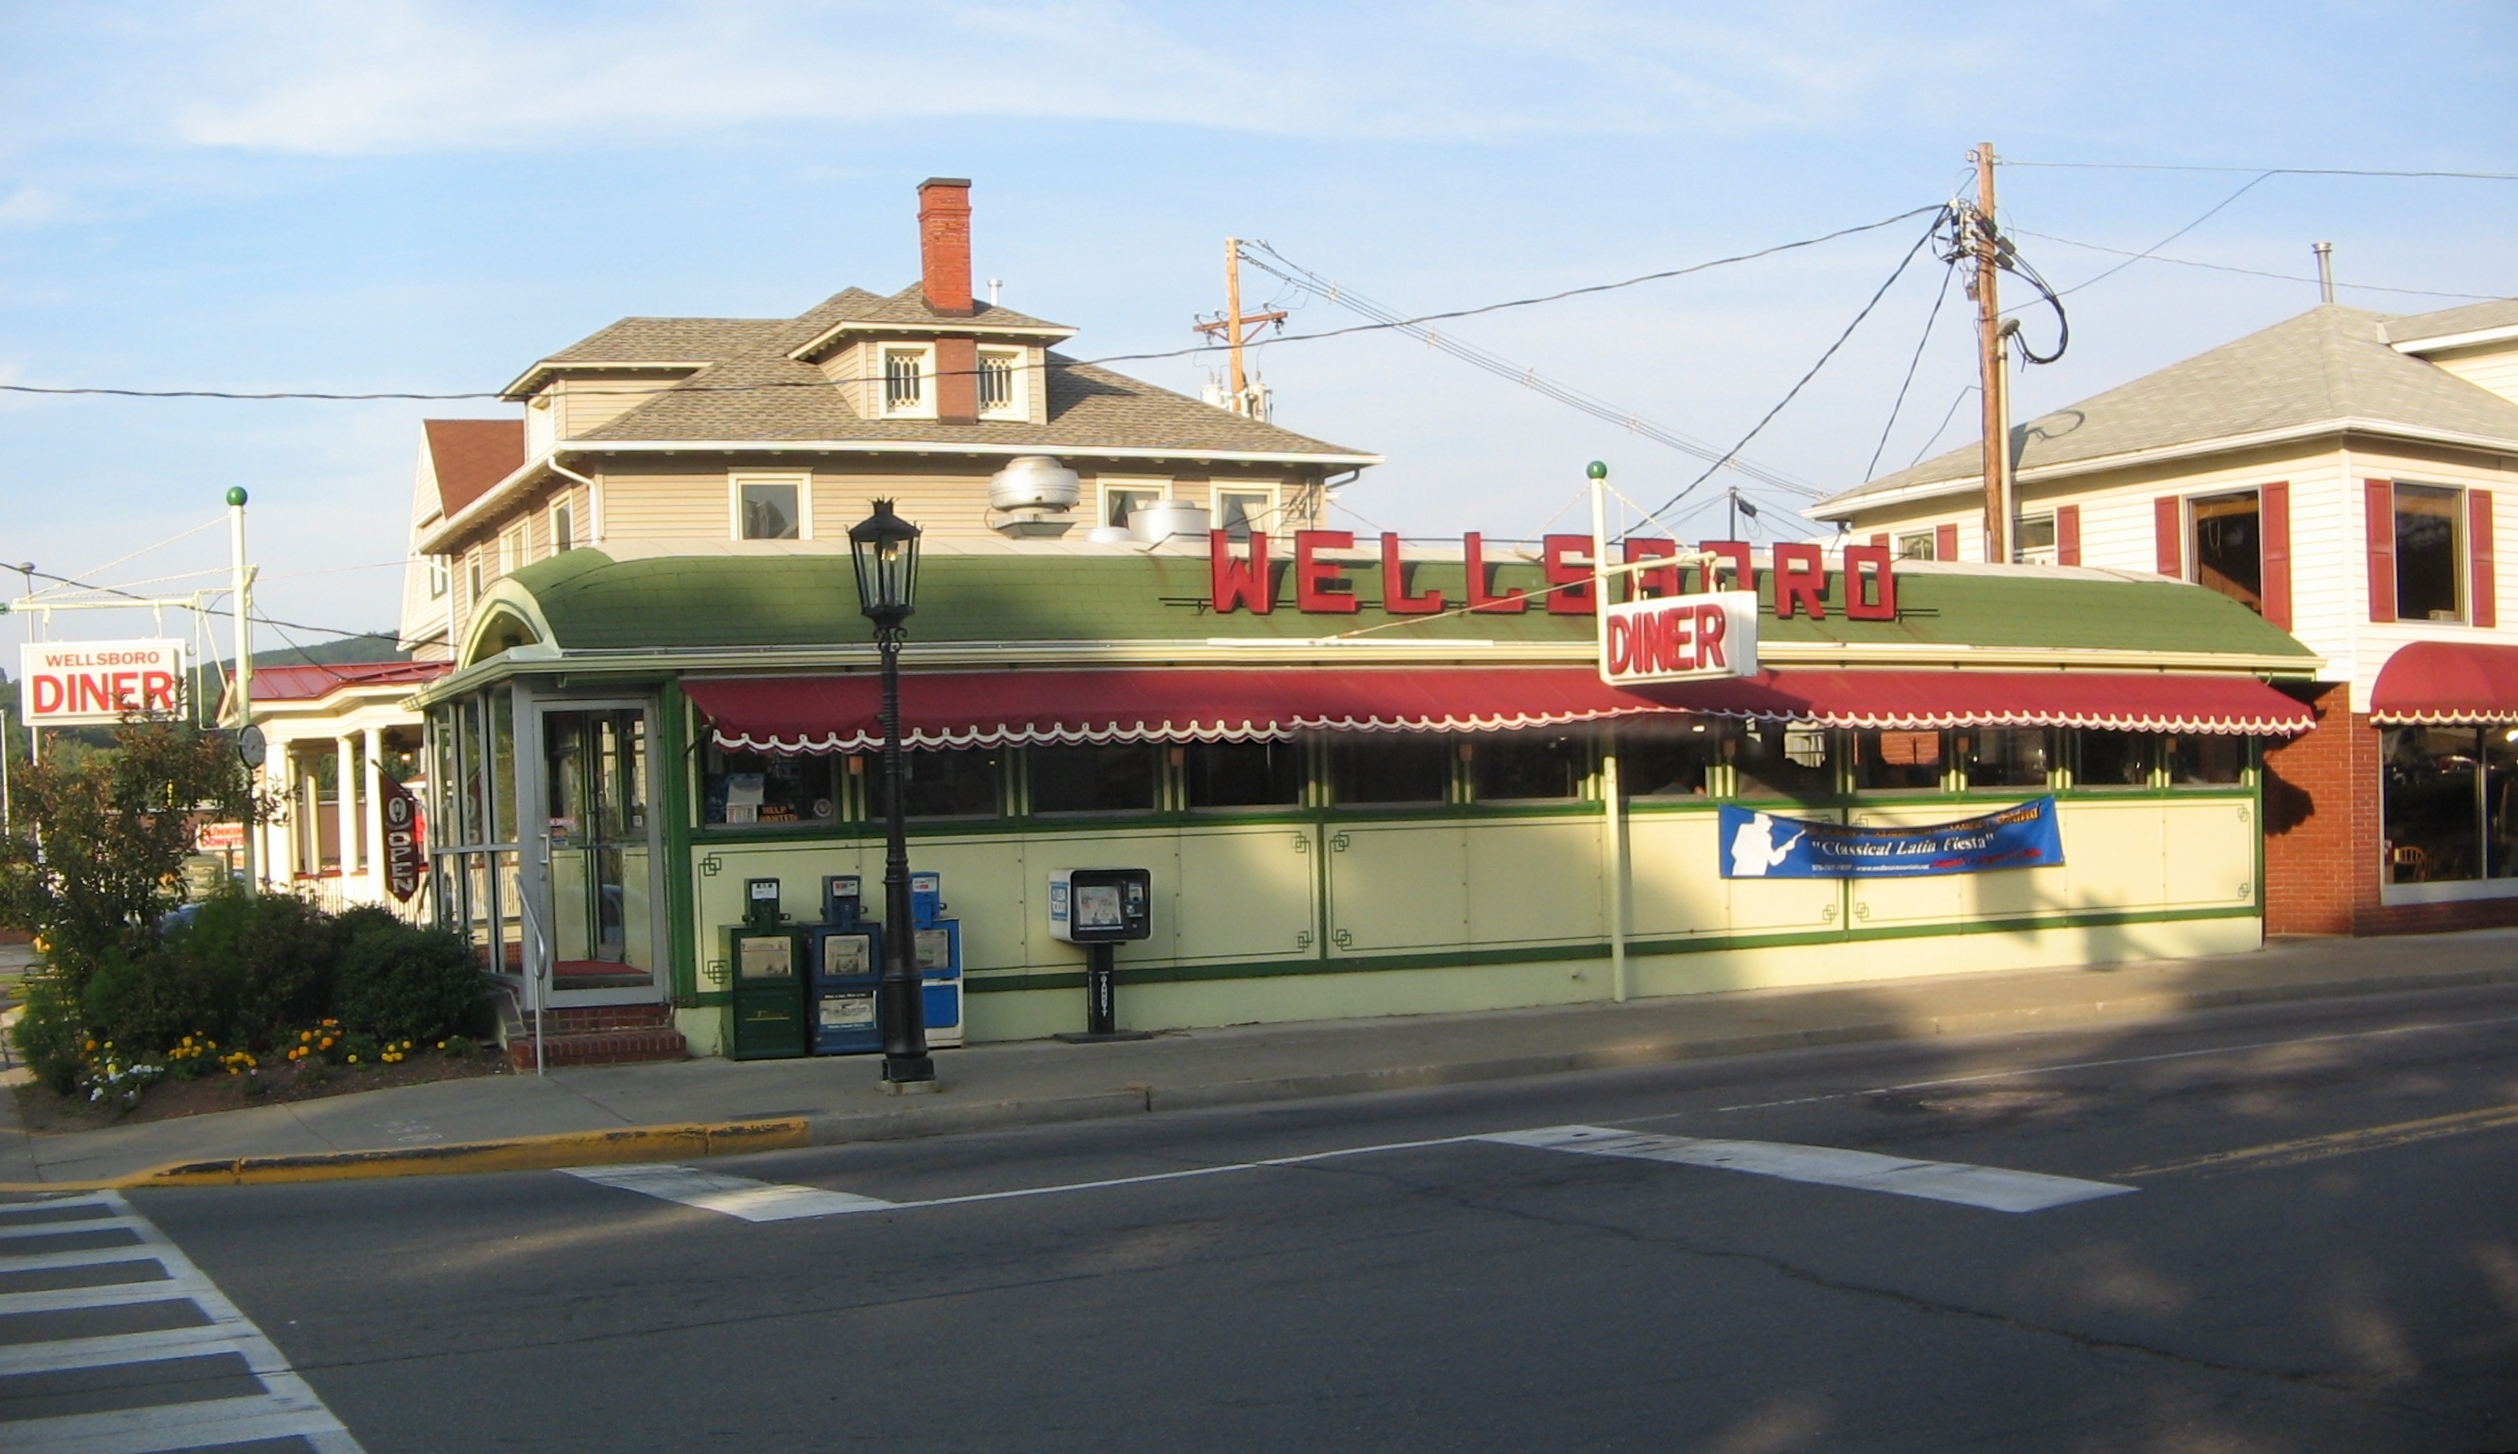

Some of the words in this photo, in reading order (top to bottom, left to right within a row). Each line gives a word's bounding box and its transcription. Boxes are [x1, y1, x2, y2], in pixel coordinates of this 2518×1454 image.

[1210, 529, 1895, 621] WELLSBORO
[46, 651, 160, 668] WELLSBORO
[1609, 604, 1726, 676] DINER
[32, 671, 174, 714] DINER
[388, 831, 414, 893] OPEN
[1811, 841, 1891, 857] "Classical
[1897, 839, 1936, 855] Latin
[1942, 833, 1994, 852] Fiesta"
